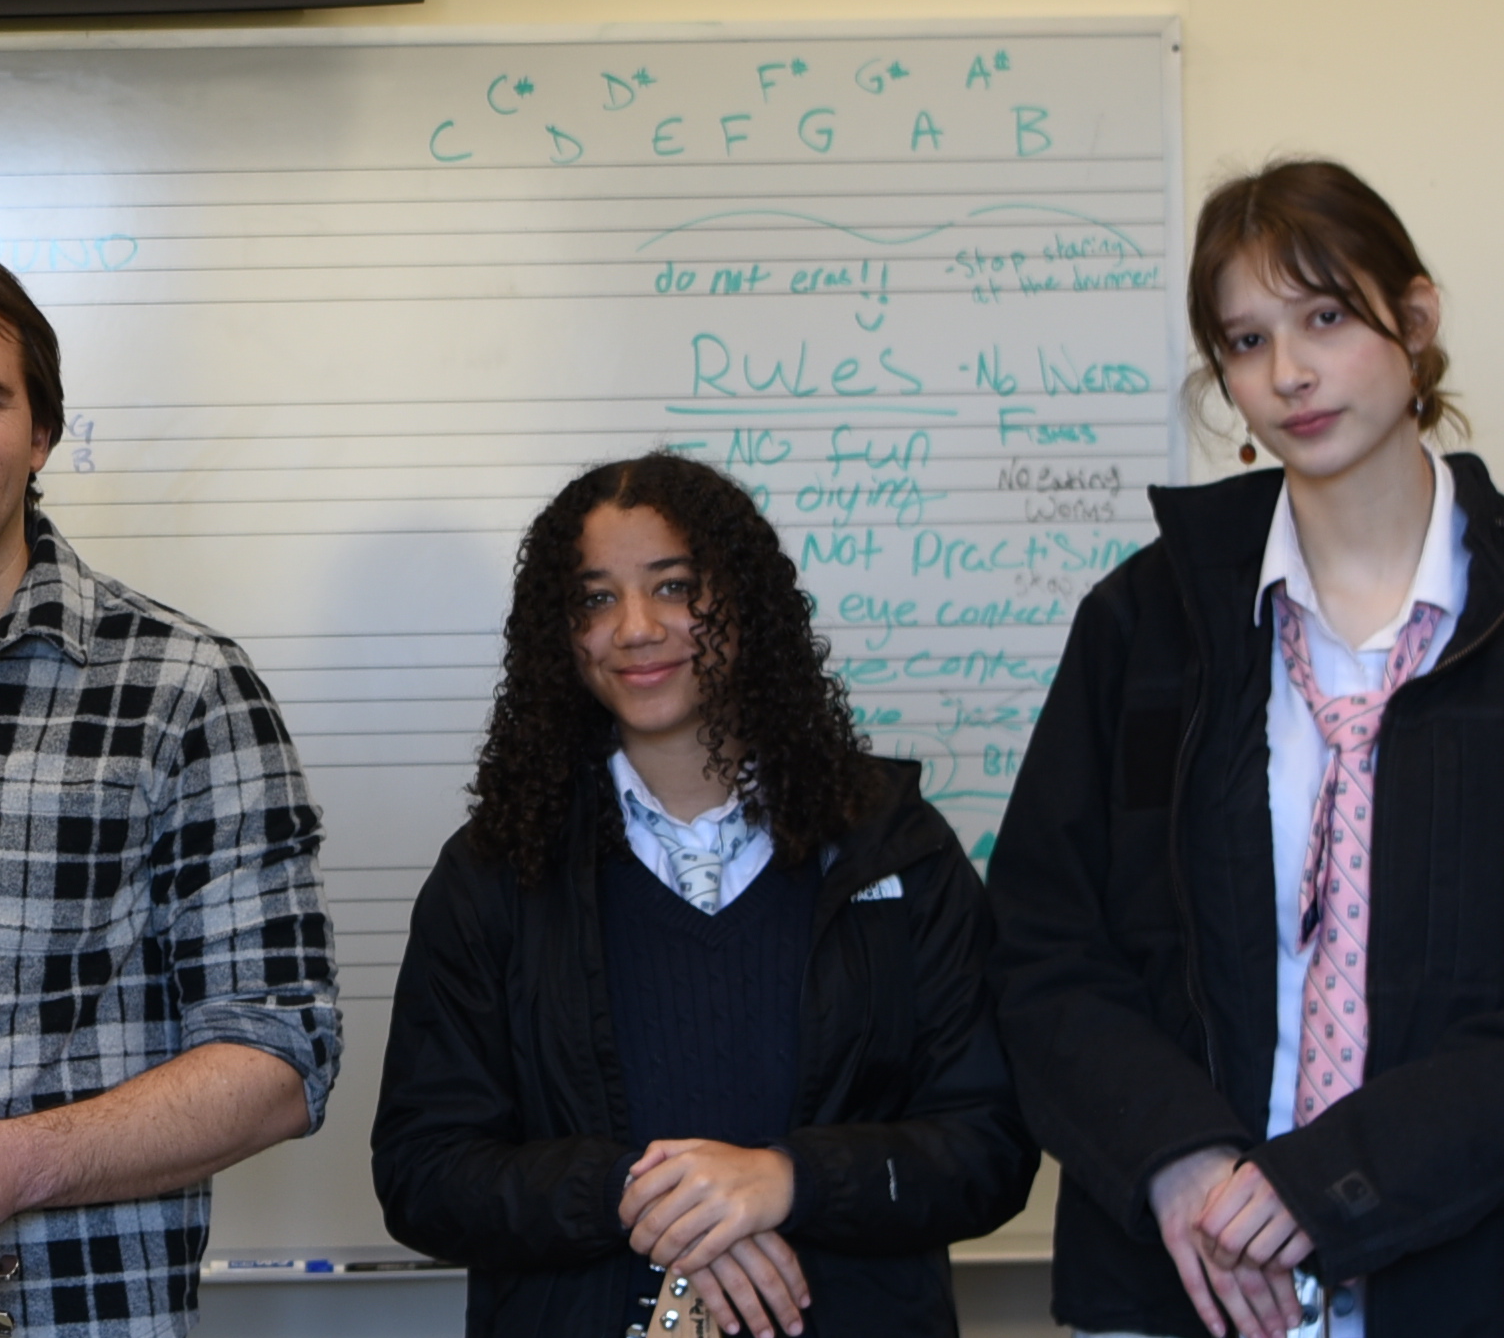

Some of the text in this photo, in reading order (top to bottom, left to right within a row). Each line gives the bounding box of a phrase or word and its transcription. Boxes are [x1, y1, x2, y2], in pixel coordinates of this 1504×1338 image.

[429, 105, 1052, 164] C D E F G A B
[1042, 233, 1127, 261] staring
[654, 261, 694, 294] do
[709, 263, 771, 295] not
[971, 280, 1001, 305] at
[1020, 272, 1061, 299] the
[825, 422, 931, 476] fun
[800, 527, 884, 573] Not
[837, 592, 1067, 651] eye contact
